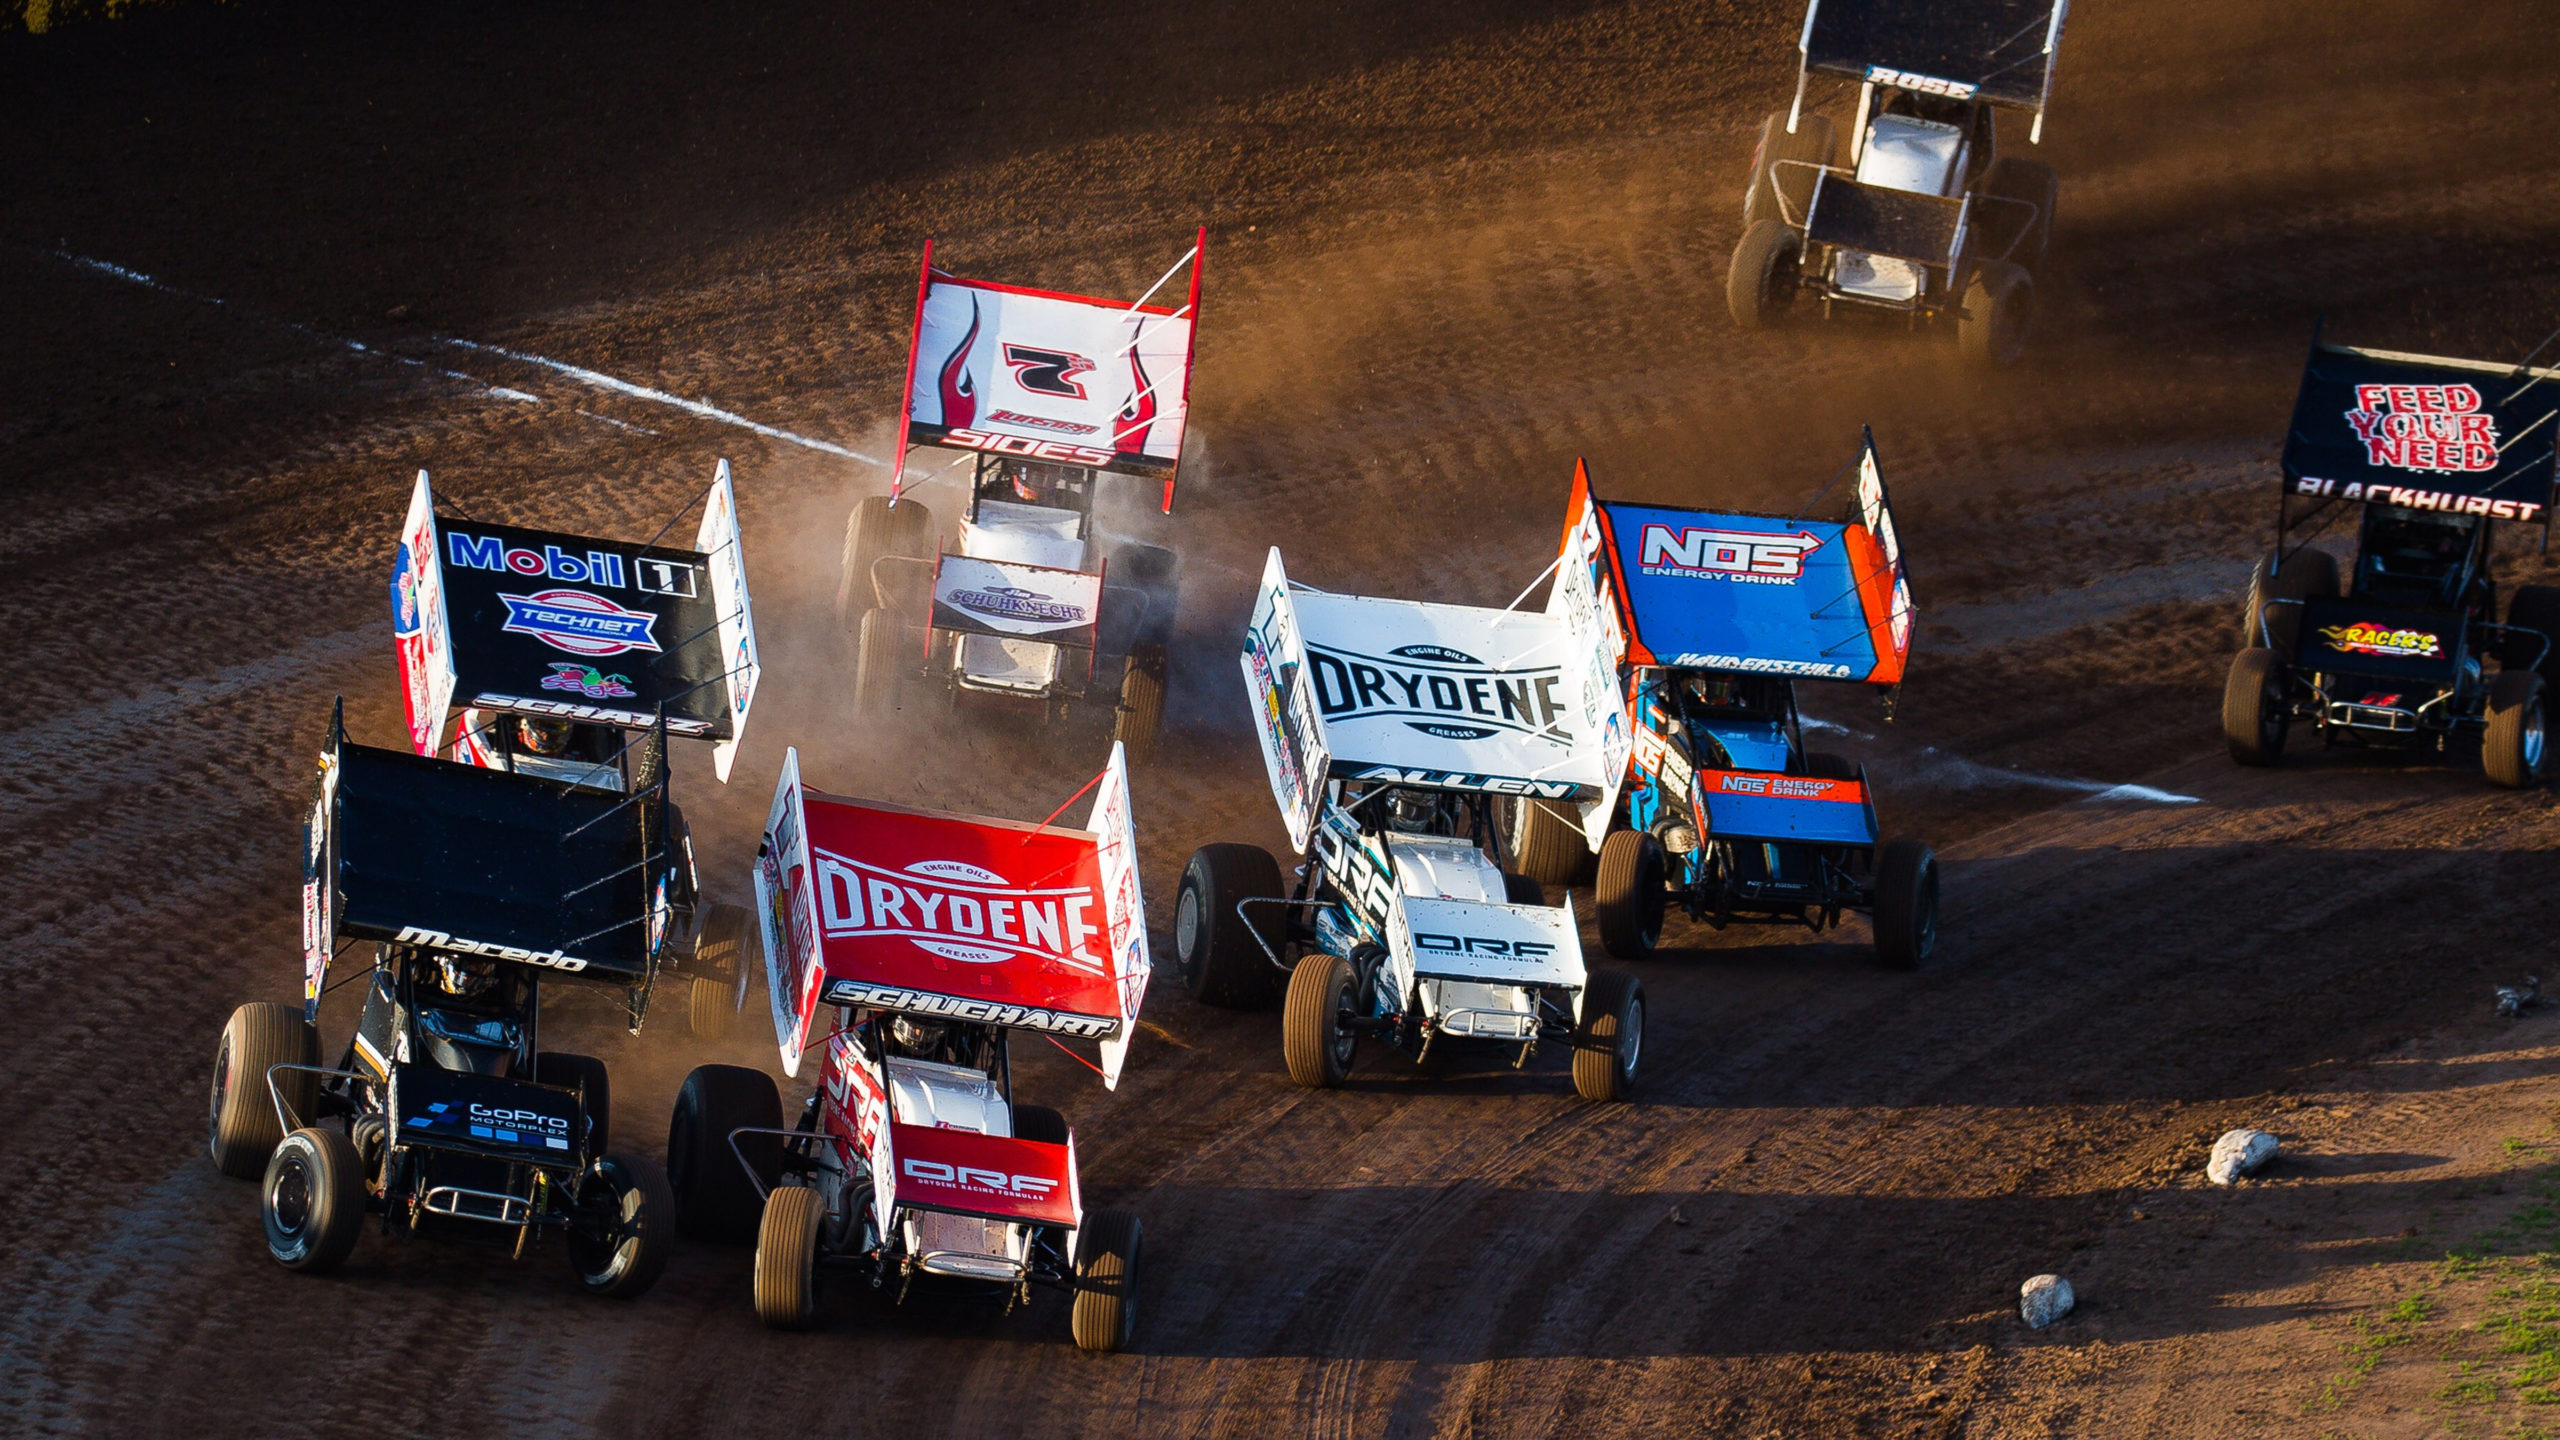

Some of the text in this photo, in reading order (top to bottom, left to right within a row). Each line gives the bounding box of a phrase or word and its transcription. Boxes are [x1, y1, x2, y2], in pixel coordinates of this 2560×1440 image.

[2355, 384, 2483, 415] FEED
[2346, 409, 2497, 443] YOUR
[941, 428, 1119, 466] SIDES
[2365, 439, 2500, 472] NEED
[2297, 476, 2541, 522] BLACKHURST
[448, 532, 676, 592] Mobil 1
[1639, 524, 1822, 576] NOS
[1642, 567, 1796, 586] ENERGY DRINK
[948, 589, 1086, 621] SCHUHKNECHT
[2346, 628, 2434, 650] RACER'S
[1404, 647, 1469, 662] ENGINE OILS
[1673, 652, 1851, 679] HAUDENSCHILD
[1305, 649, 1574, 740] DRYDENE
[1428, 727, 1478, 738] GREASES
[1353, 767, 1578, 798] ALLEN
[1721, 775, 1834, 793] NOS ENERGY
[1772, 787, 1819, 797] DRINK
[922, 863, 992, 881] ENGINE OILS
[816, 857, 1104, 967] DRYDENE
[937, 945, 990, 960] GREASES
[1414, 932, 1556, 956] DRF
[1469, 952, 1499, 961] RACING
[829, 983, 1116, 1037] SCHUCHART
[470, 1103, 568, 1128] GoPro
[470, 1116, 567, 1136] MOTORPLEX
[904, 1158, 1059, 1193] DRF
[917, 1178, 1045, 1202] DRYDENE RACING FORMULAS
